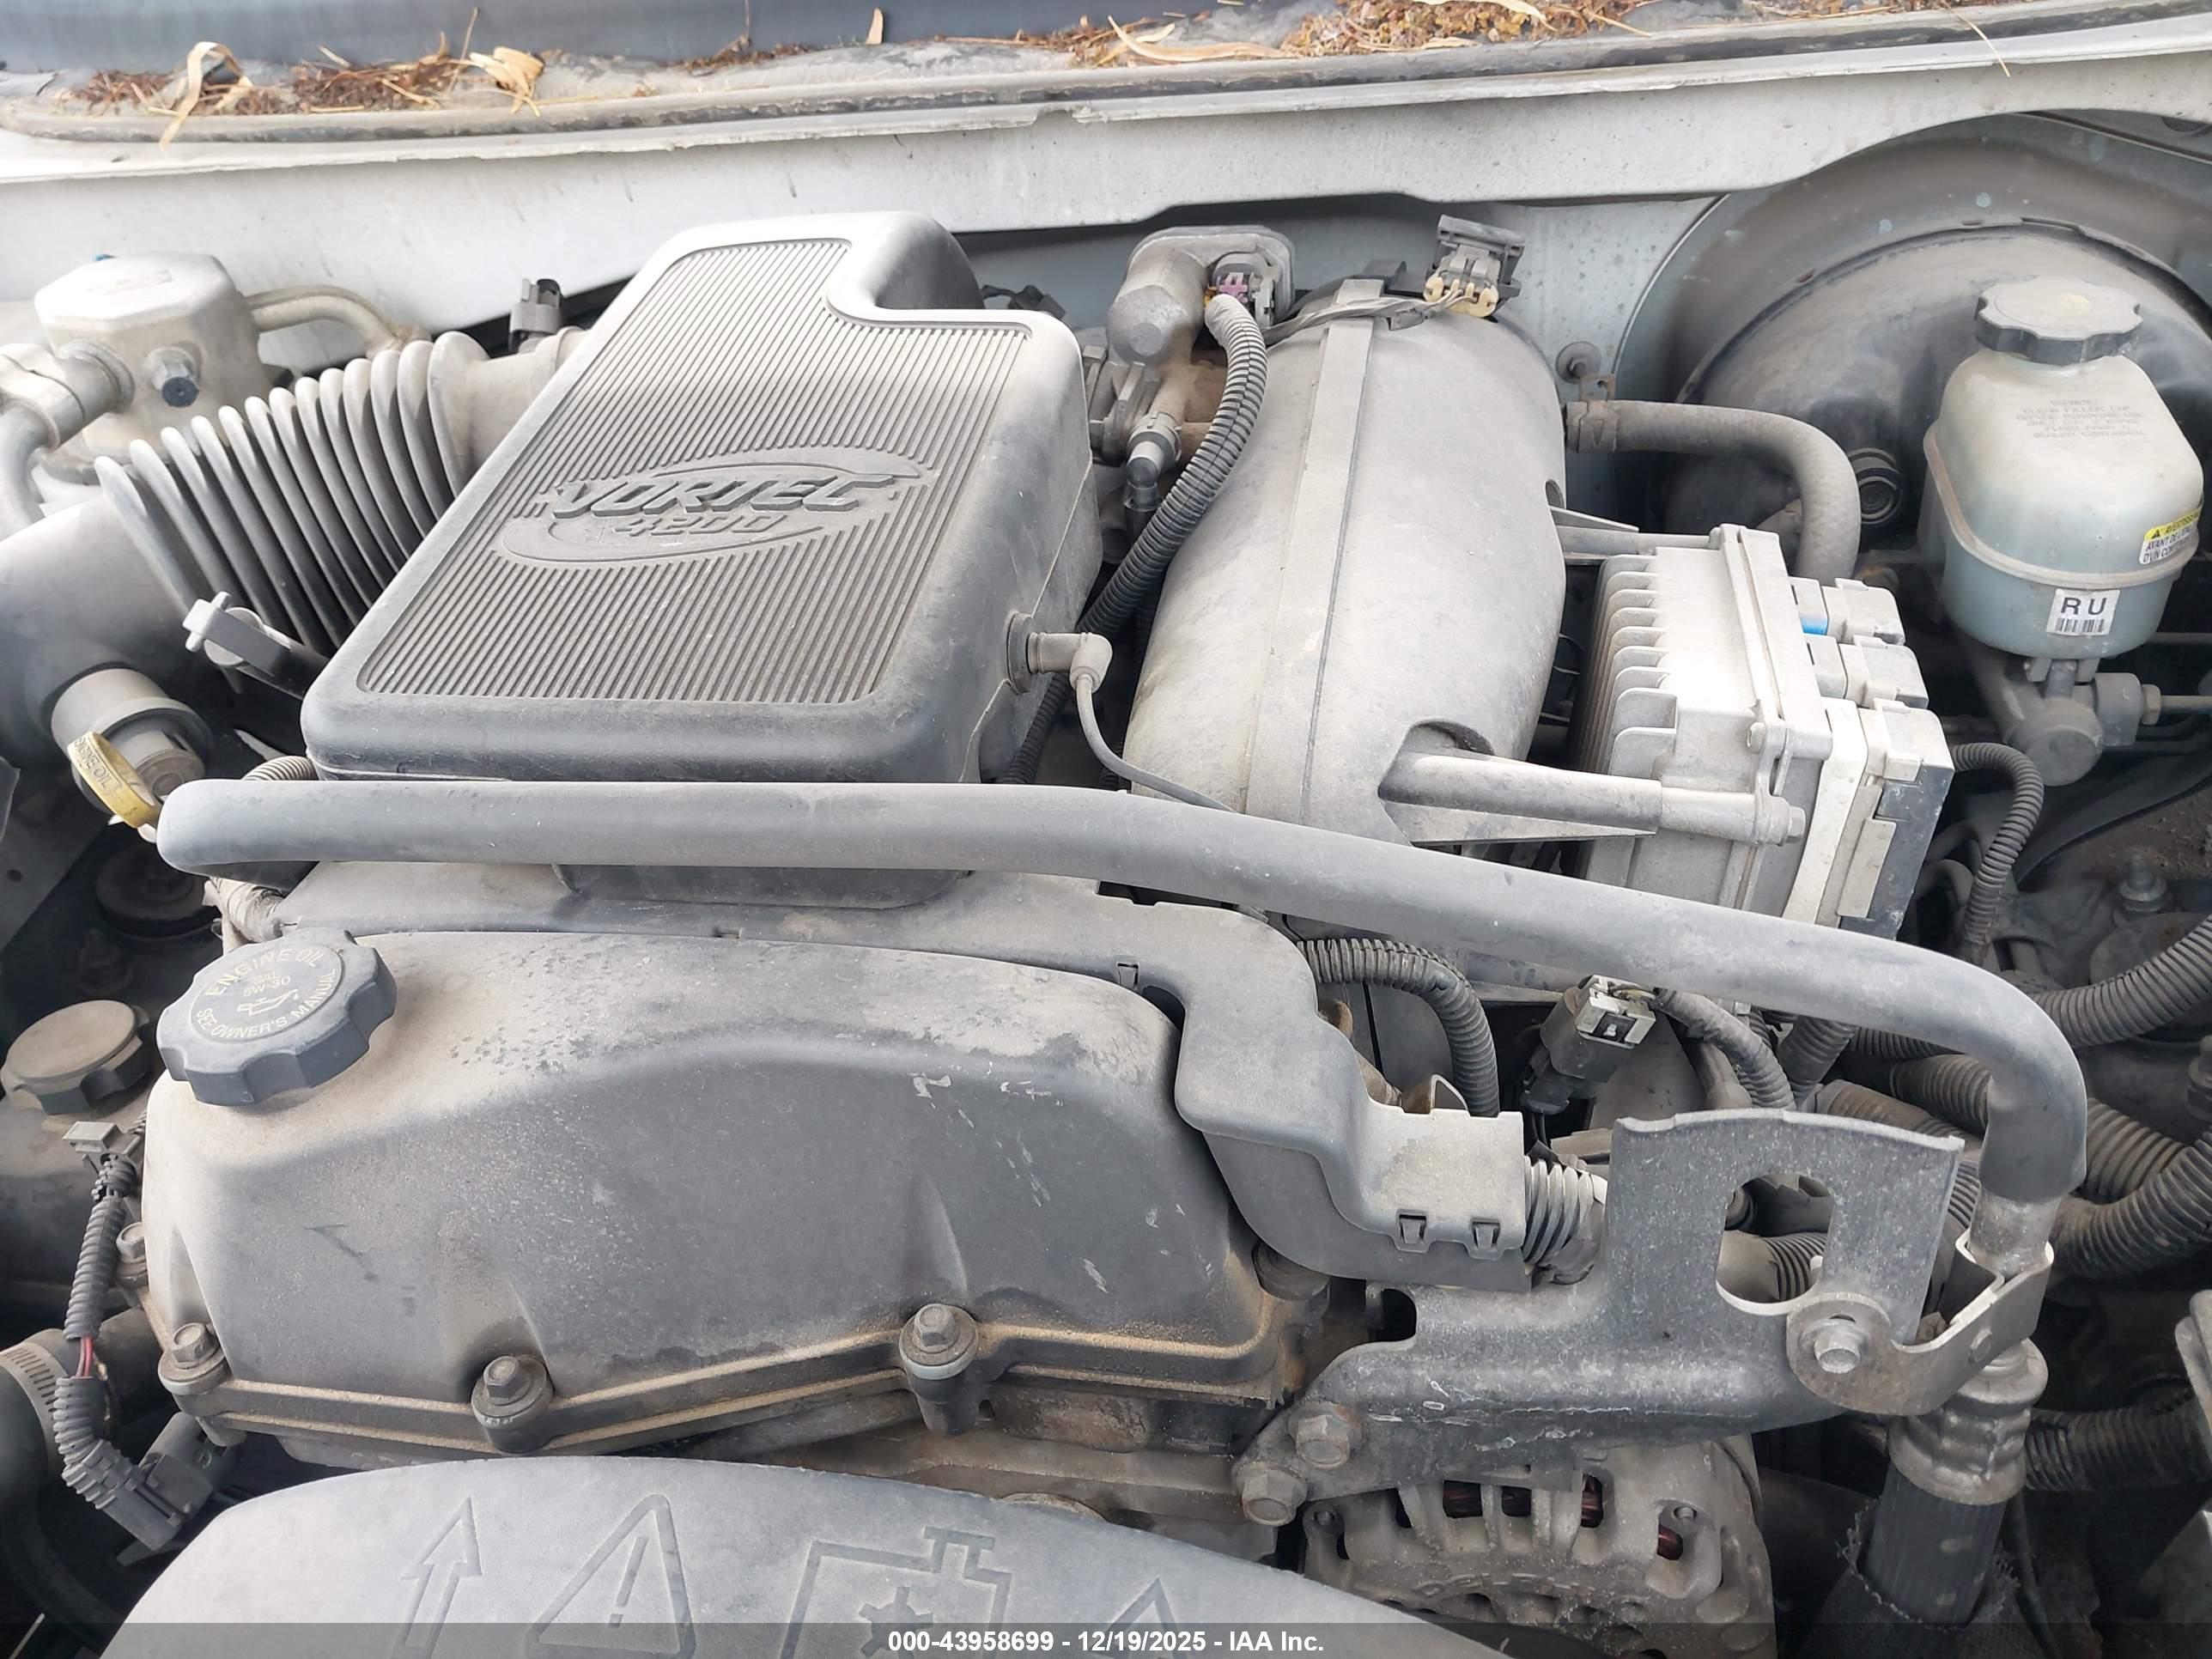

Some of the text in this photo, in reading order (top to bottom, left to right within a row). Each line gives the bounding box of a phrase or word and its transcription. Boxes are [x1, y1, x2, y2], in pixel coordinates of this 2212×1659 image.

[552, 474, 895, 519] VORTEC
[613, 514, 789, 537] 4200
[93, 766, 112, 789] OIL
[205, 947, 325, 996] ENGINE OIL
[196, 968, 337, 1039] SEE OWNER'S MANUAL
